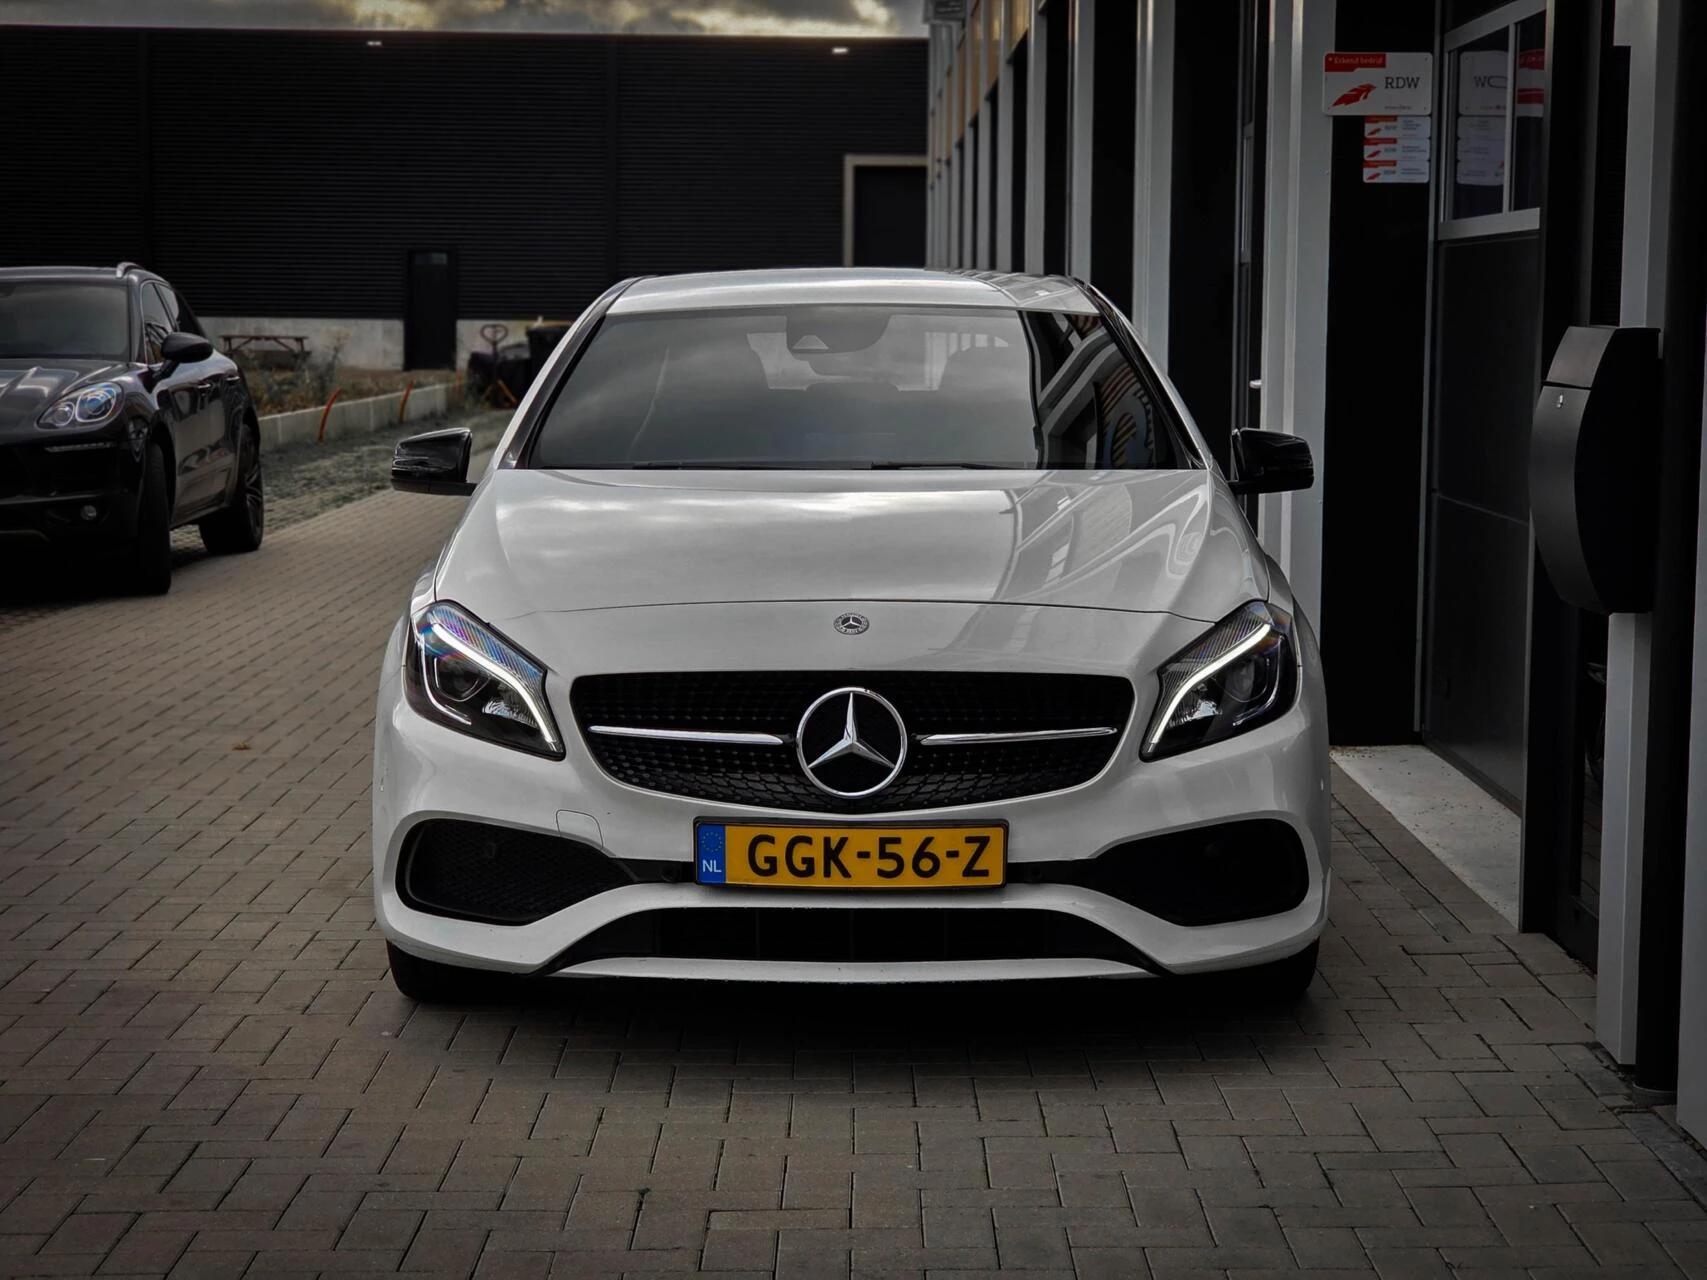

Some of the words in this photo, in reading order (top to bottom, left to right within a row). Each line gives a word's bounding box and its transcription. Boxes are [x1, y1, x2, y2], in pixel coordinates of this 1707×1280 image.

[1384, 76, 1420, 89] RDW
[747, 833, 991, 879] GGK-56-Z
[702, 859, 722, 873] NL
